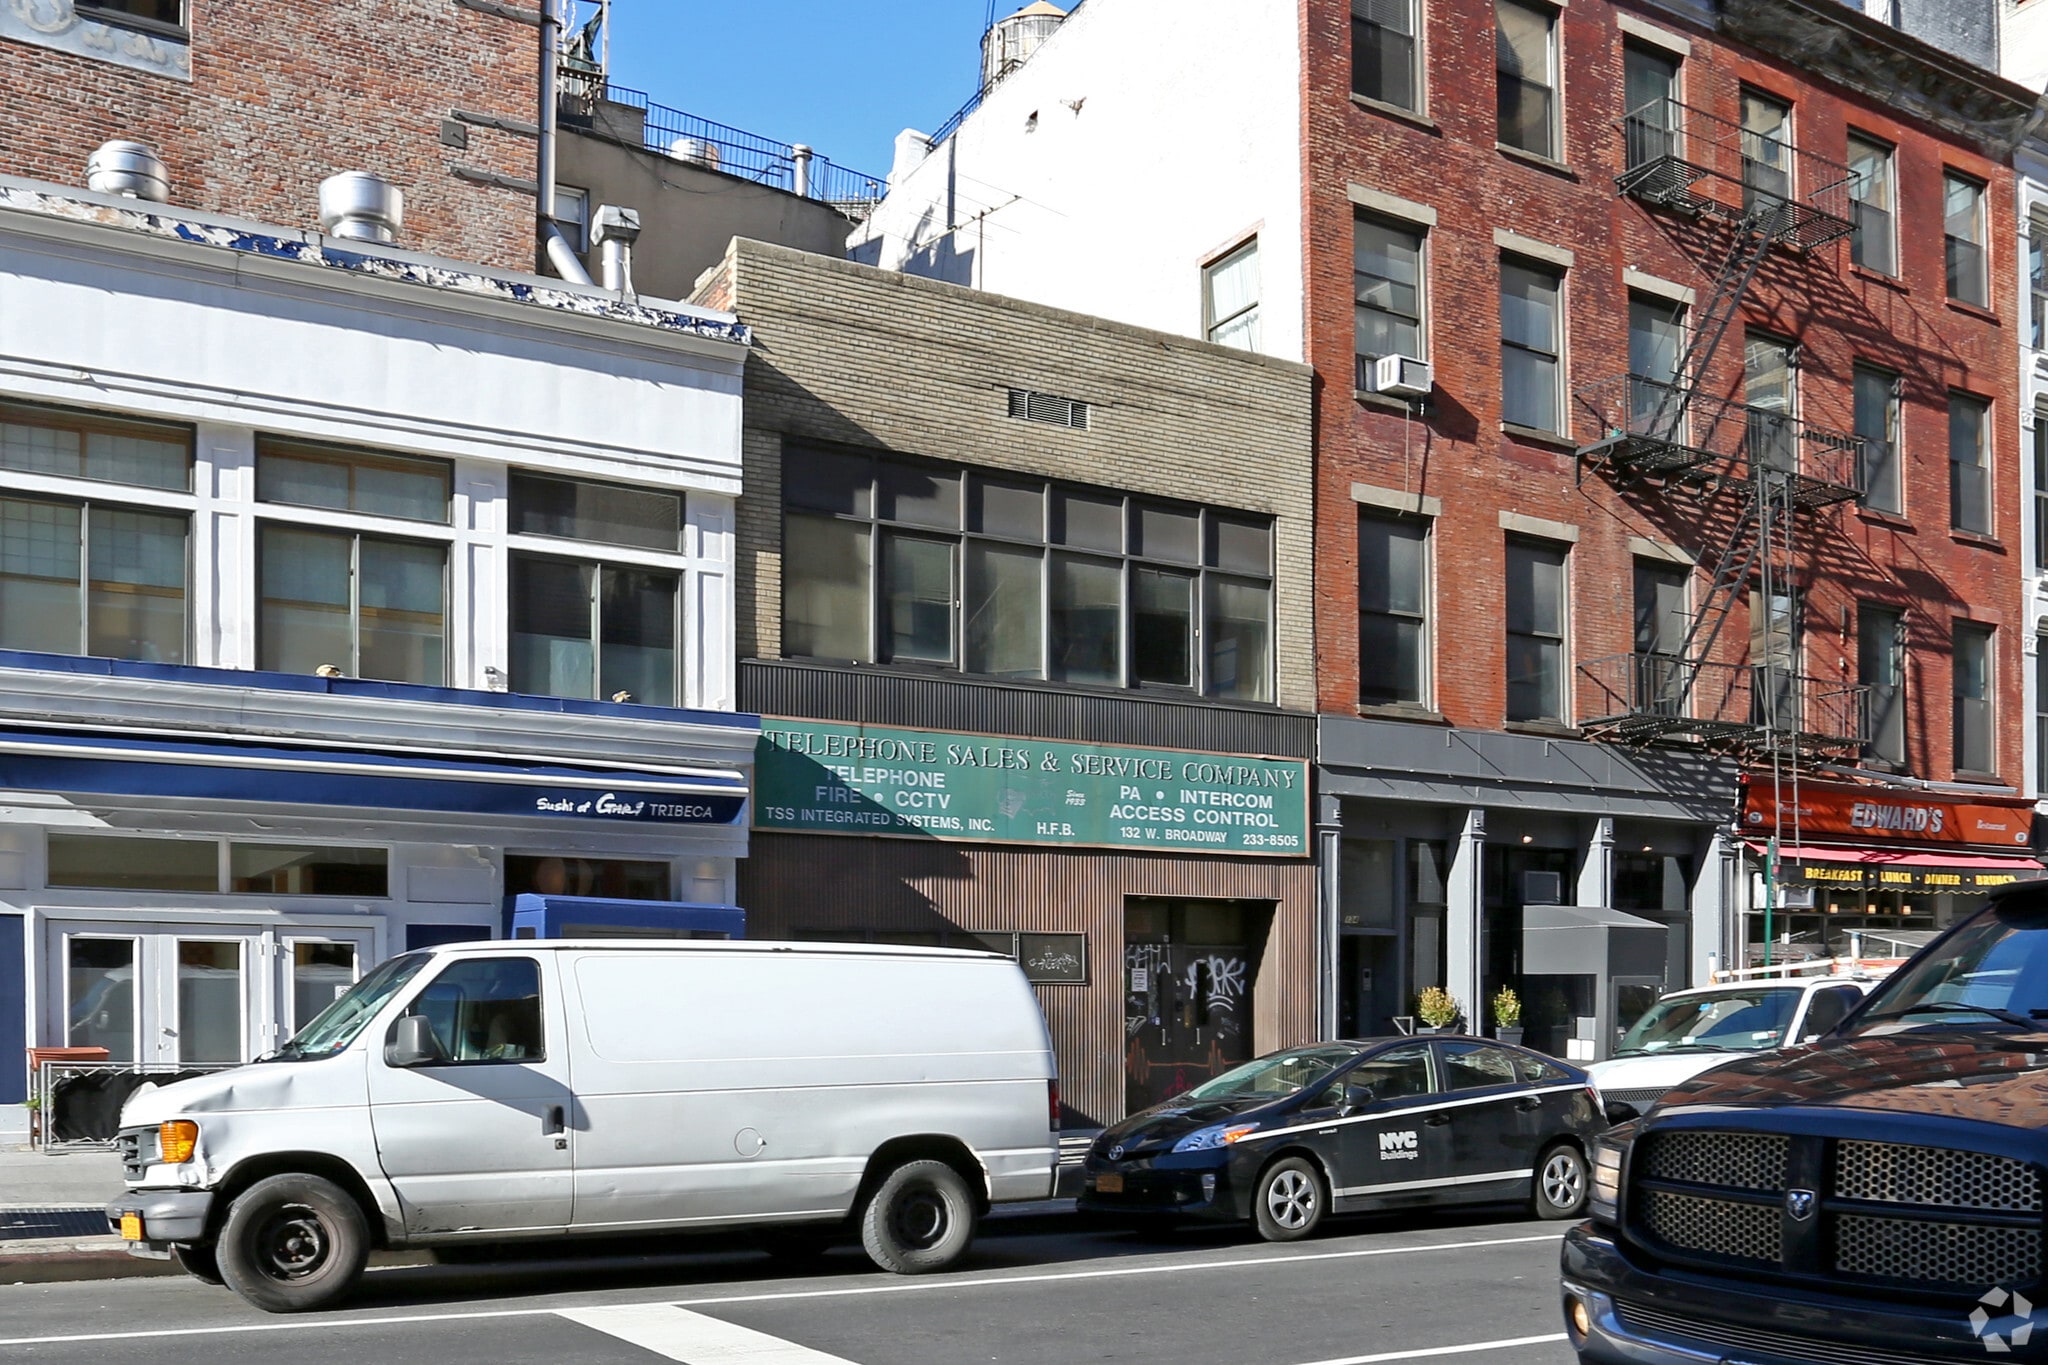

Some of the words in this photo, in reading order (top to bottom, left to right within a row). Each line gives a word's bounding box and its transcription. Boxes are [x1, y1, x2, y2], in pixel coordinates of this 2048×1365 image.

[764, 730, 937, 763] TELEPHONE
[947, 743, 1030, 770] SALES
[1040, 750, 1061, 772] &
[1070, 753, 1173, 780] SERVICE
[1182, 761, 1297, 789] COMPANY
[823, 764, 946, 788] TELEPHONE
[536, 797, 574, 812] Sushi
[650, 803, 713, 818] TRIBECA
[815, 785, 862, 803] FIRE
[894, 790, 951, 809] CCTV
[1120, 785, 1141, 800] PA
[1180, 789, 1273, 809] INTERCOM
[766, 807, 795, 820] TSS
[801, 809, 890, 825] INTEGRATED
[896, 814, 964, 831] SYSTEMS,
[968, 818, 995, 831] INC.
[1110, 805, 1185, 823] ACCESS
[1193, 809, 1279, 828] CONTROL
[1851, 803, 1943, 833] EDWARD'S
[1037, 822, 1075, 836] H.F.B.
[1120, 827, 1140, 839] 132
[1145, 828, 1160, 840] W.
[1165, 828, 1228, 843] BROADWAY
[1243, 834, 1298, 846] 233-8505
[1805, 867, 1863, 881] BREAKFAST
[1880, 871, 1912, 884] LUNCH
[1924, 873, 1961, 885] DINNER
[1379, 1131, 1418, 1150] NYC
[1380, 1150, 1418, 1160] Buildings
